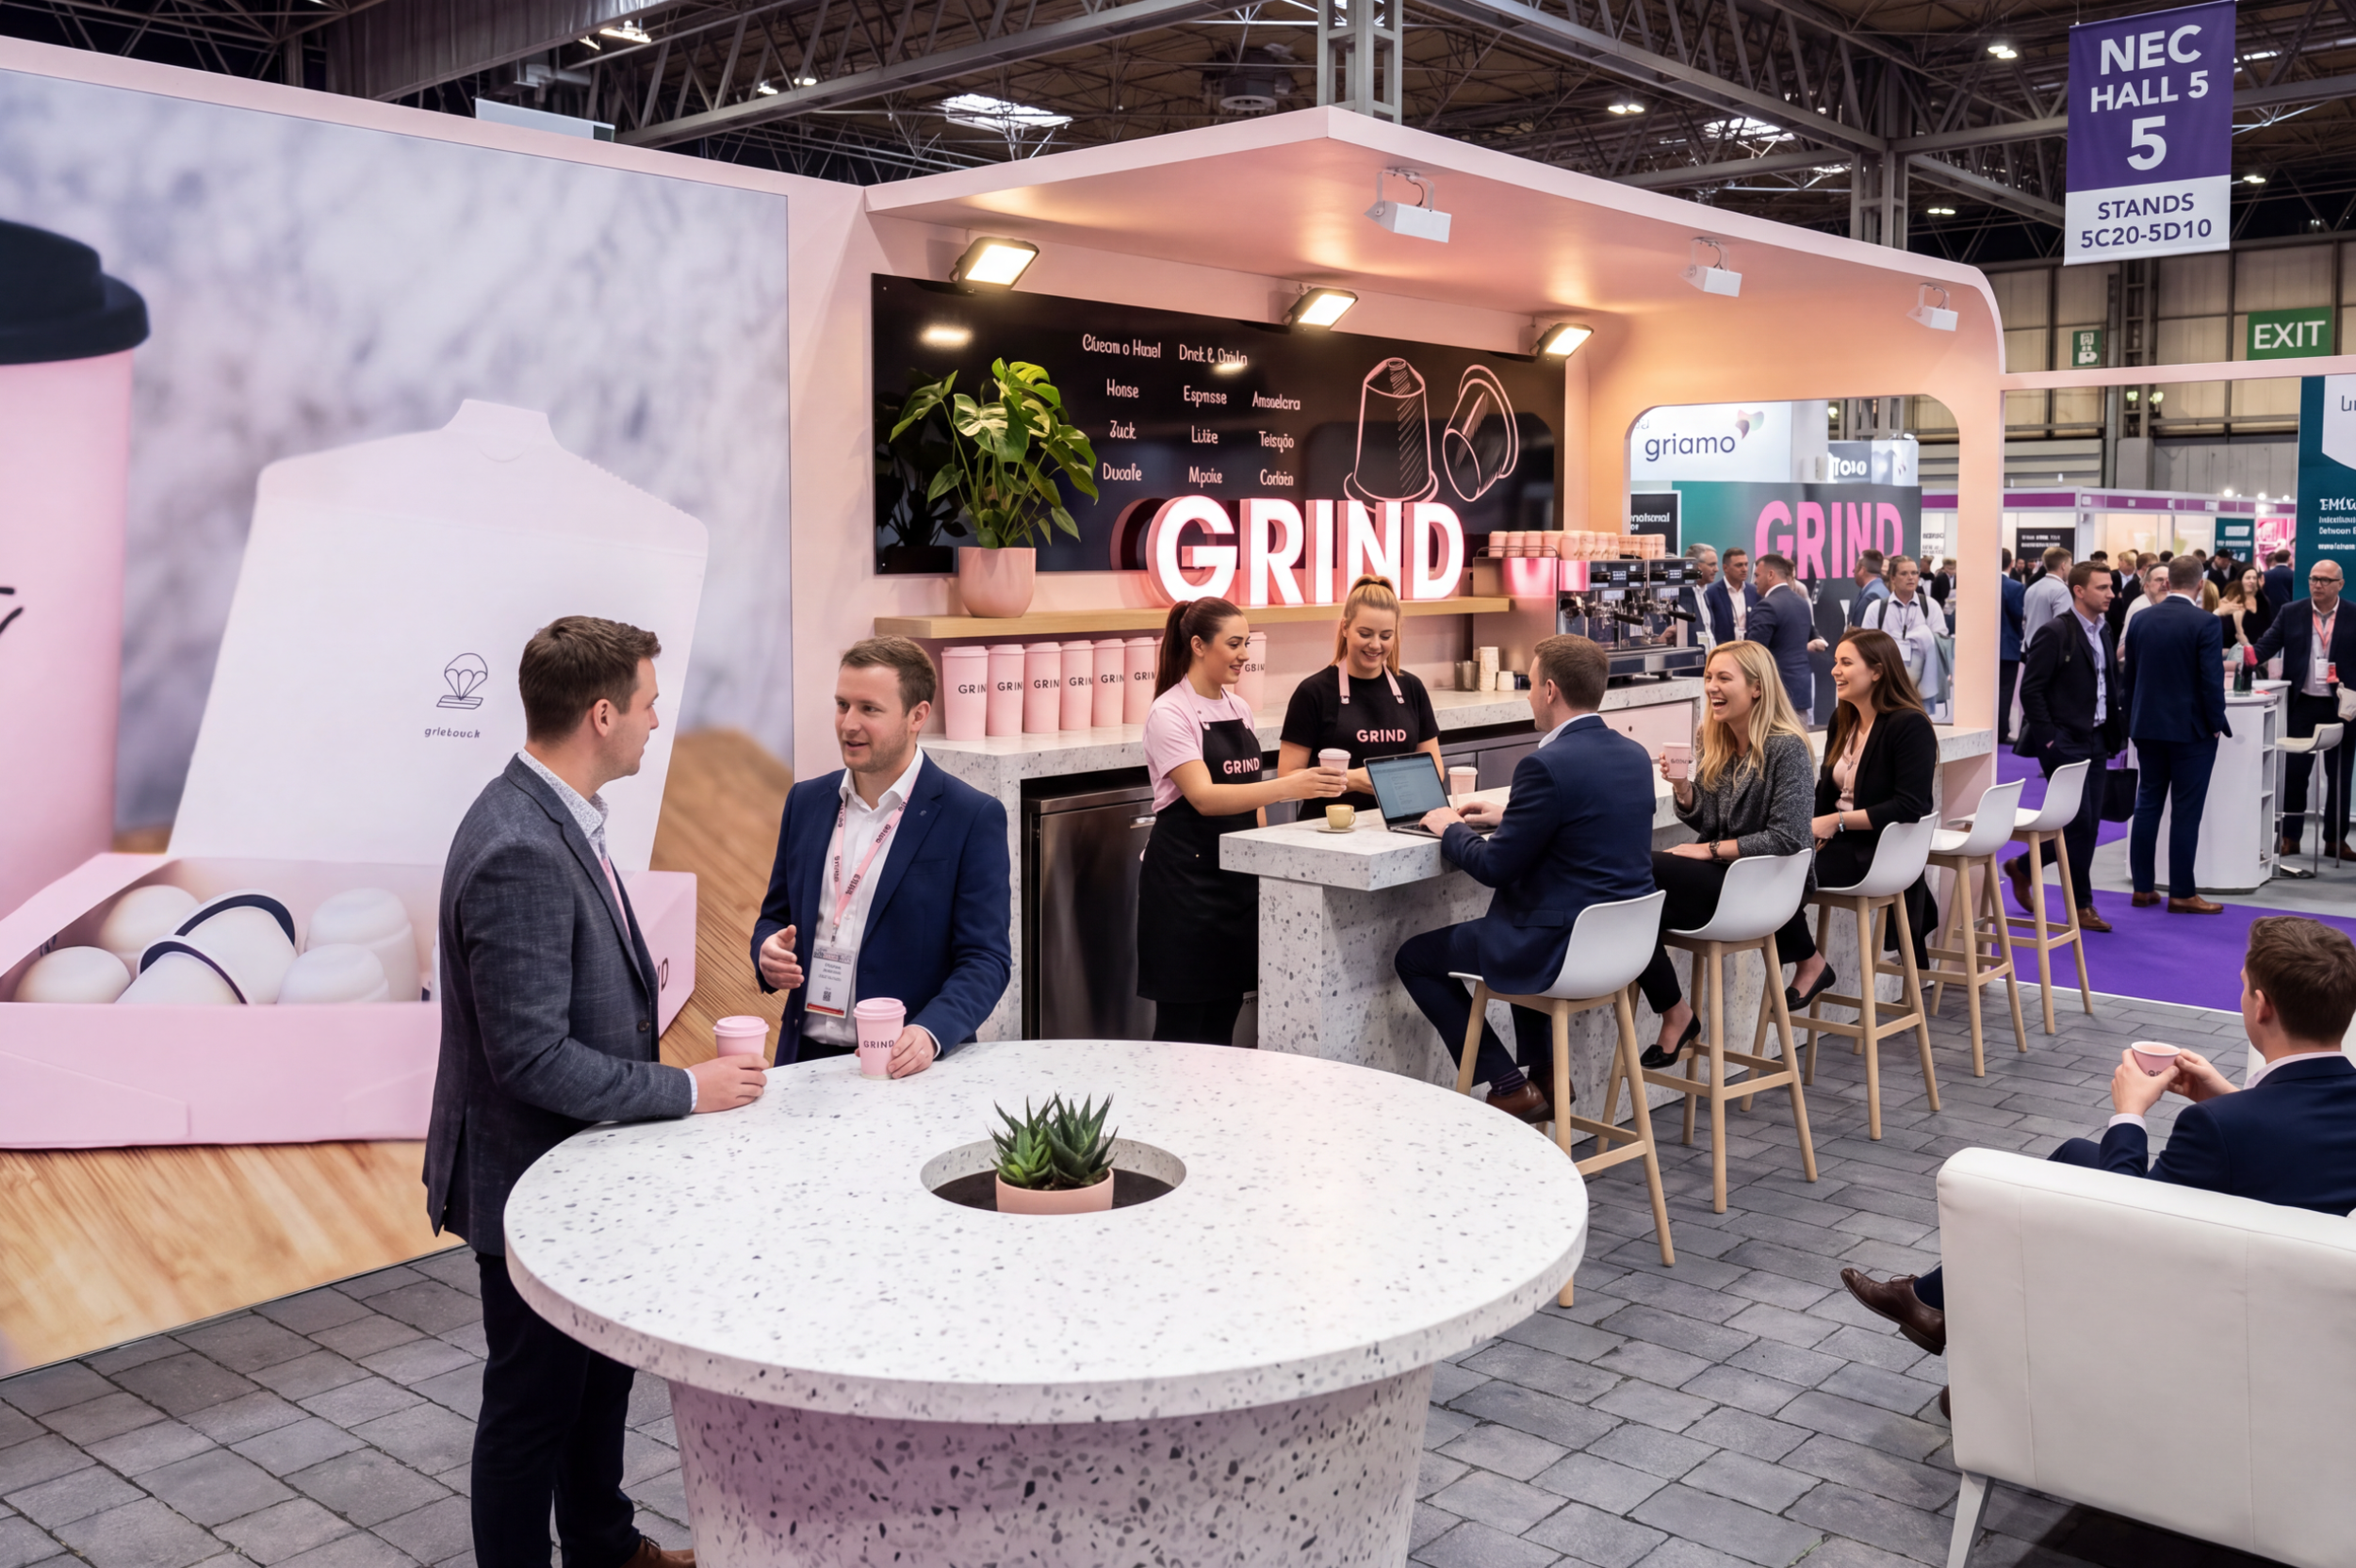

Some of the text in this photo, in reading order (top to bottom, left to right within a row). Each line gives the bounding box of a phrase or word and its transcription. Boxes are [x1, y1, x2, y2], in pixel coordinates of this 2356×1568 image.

[2101, 24, 2202, 75] NEC
[2090, 70, 2209, 113] HALL 5
[2127, 115, 2168, 171] 5
[2097, 192, 2195, 220] STANDS
[2080, 219, 2212, 248] 5C20-5D10
[2253, 320, 2326, 350] EXIT
[1644, 433, 1736, 462] griamo
[1146, 495, 1464, 608] GRIND
[1755, 500, 1904, 580] GRIND
[1356, 728, 1407, 743] GRIND
[1222, 757, 1260, 776] GRIND
[863, 1039, 894, 1049] GRIND
